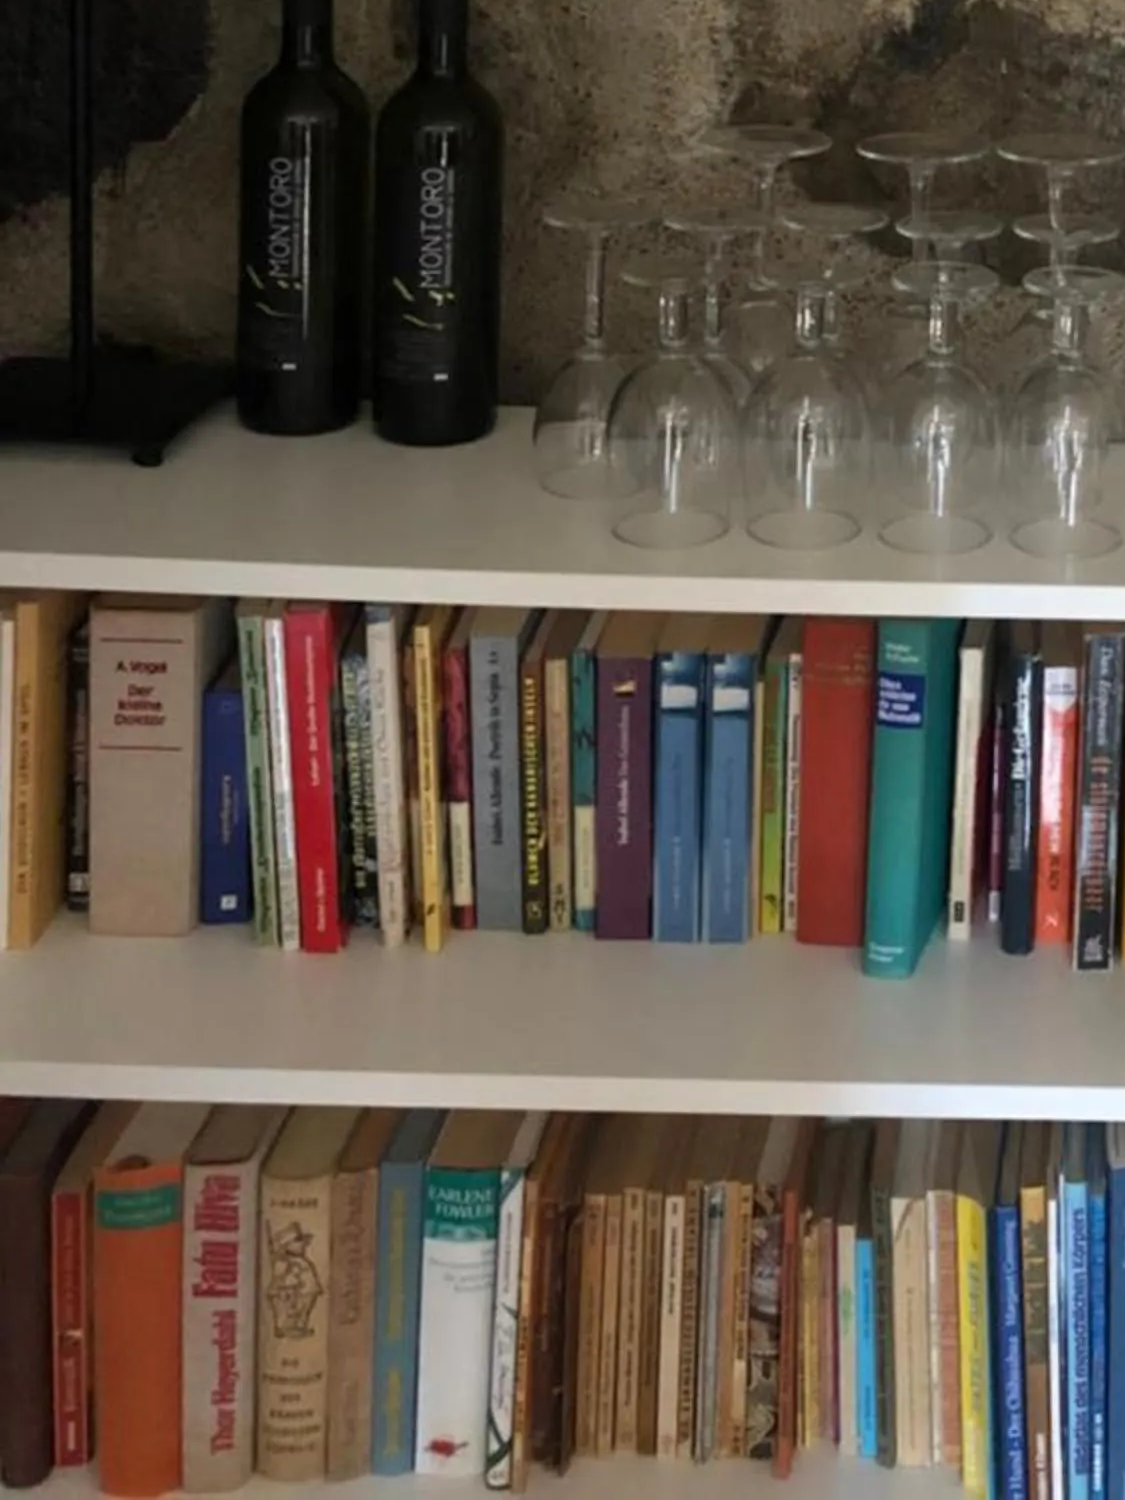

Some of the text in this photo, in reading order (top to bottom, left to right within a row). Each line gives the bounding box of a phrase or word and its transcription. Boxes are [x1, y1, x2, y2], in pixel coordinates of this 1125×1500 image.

[268, 156, 294, 279] MONTORO
[420, 166, 447, 289] MONTORO
[193, 1173, 242, 1299] Fatu Hiva
[428, 1184, 492, 1202] EARLENE
[435, 1203, 495, 1219] FOWLER
[1072, 1207, 1086, 1269] Körpers
[211, 1309, 237, 1454] Thor Heyerdahl
